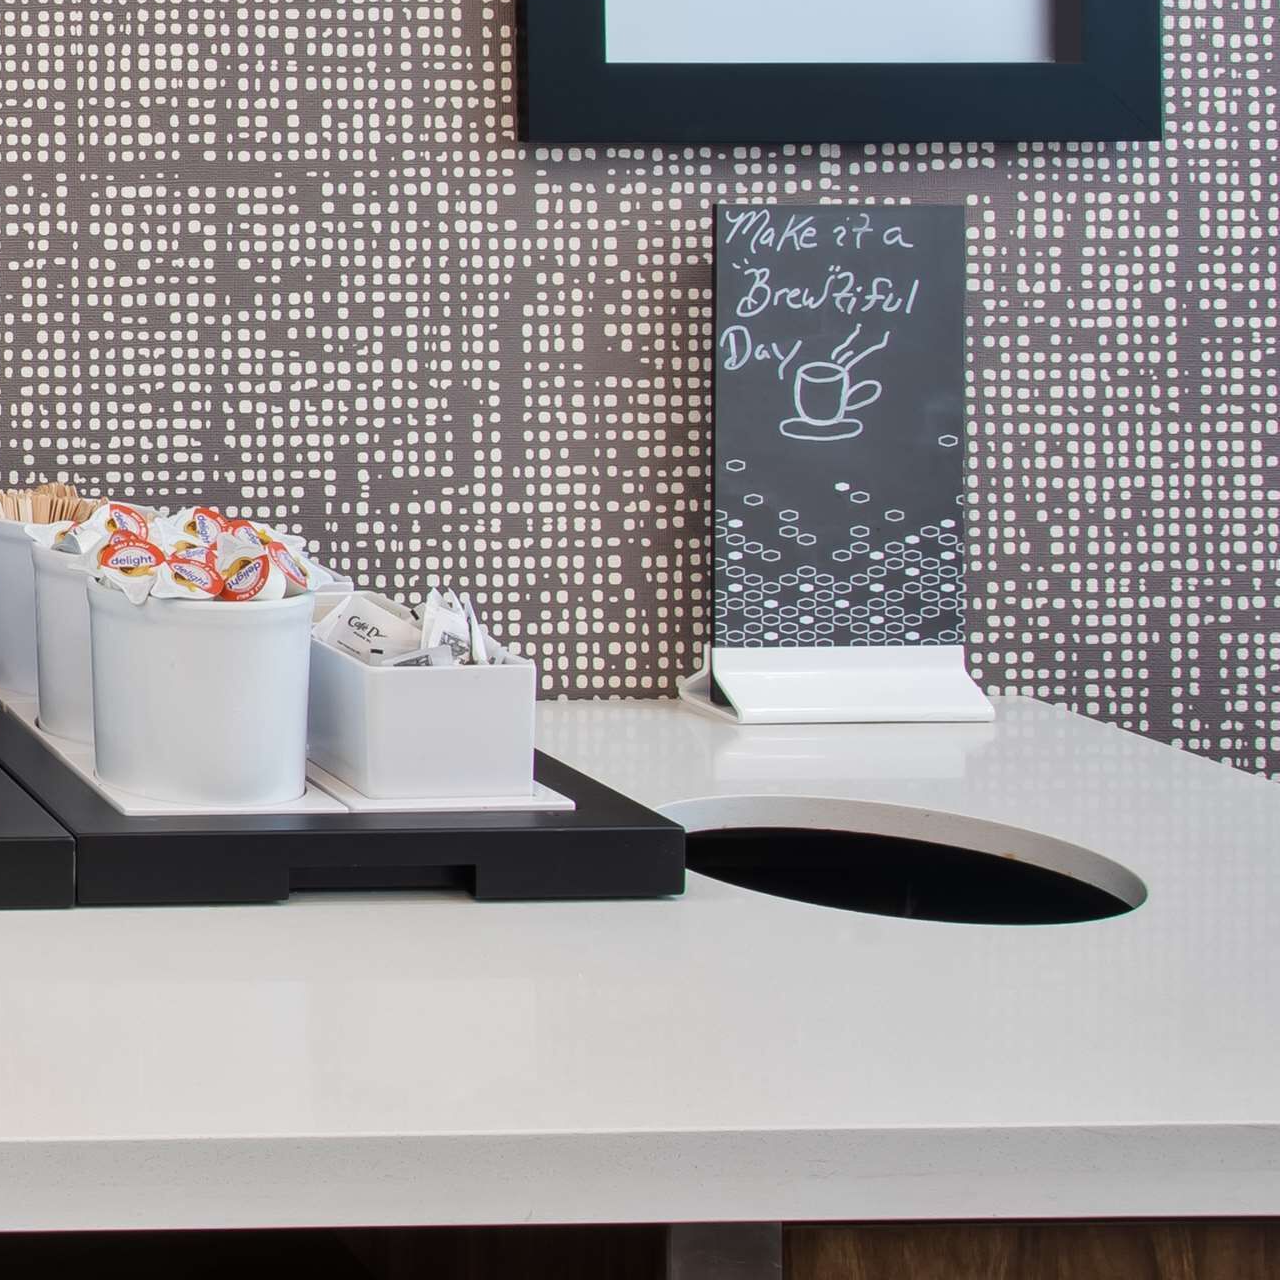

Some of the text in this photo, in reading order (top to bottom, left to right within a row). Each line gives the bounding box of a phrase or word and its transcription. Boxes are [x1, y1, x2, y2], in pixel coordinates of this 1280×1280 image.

[725, 209, 914, 253] Make it a
[719, 324, 803, 380] Day
[111, 555, 153, 567] delight
[174, 564, 209, 587] delight
[227, 561, 261, 590] delight
